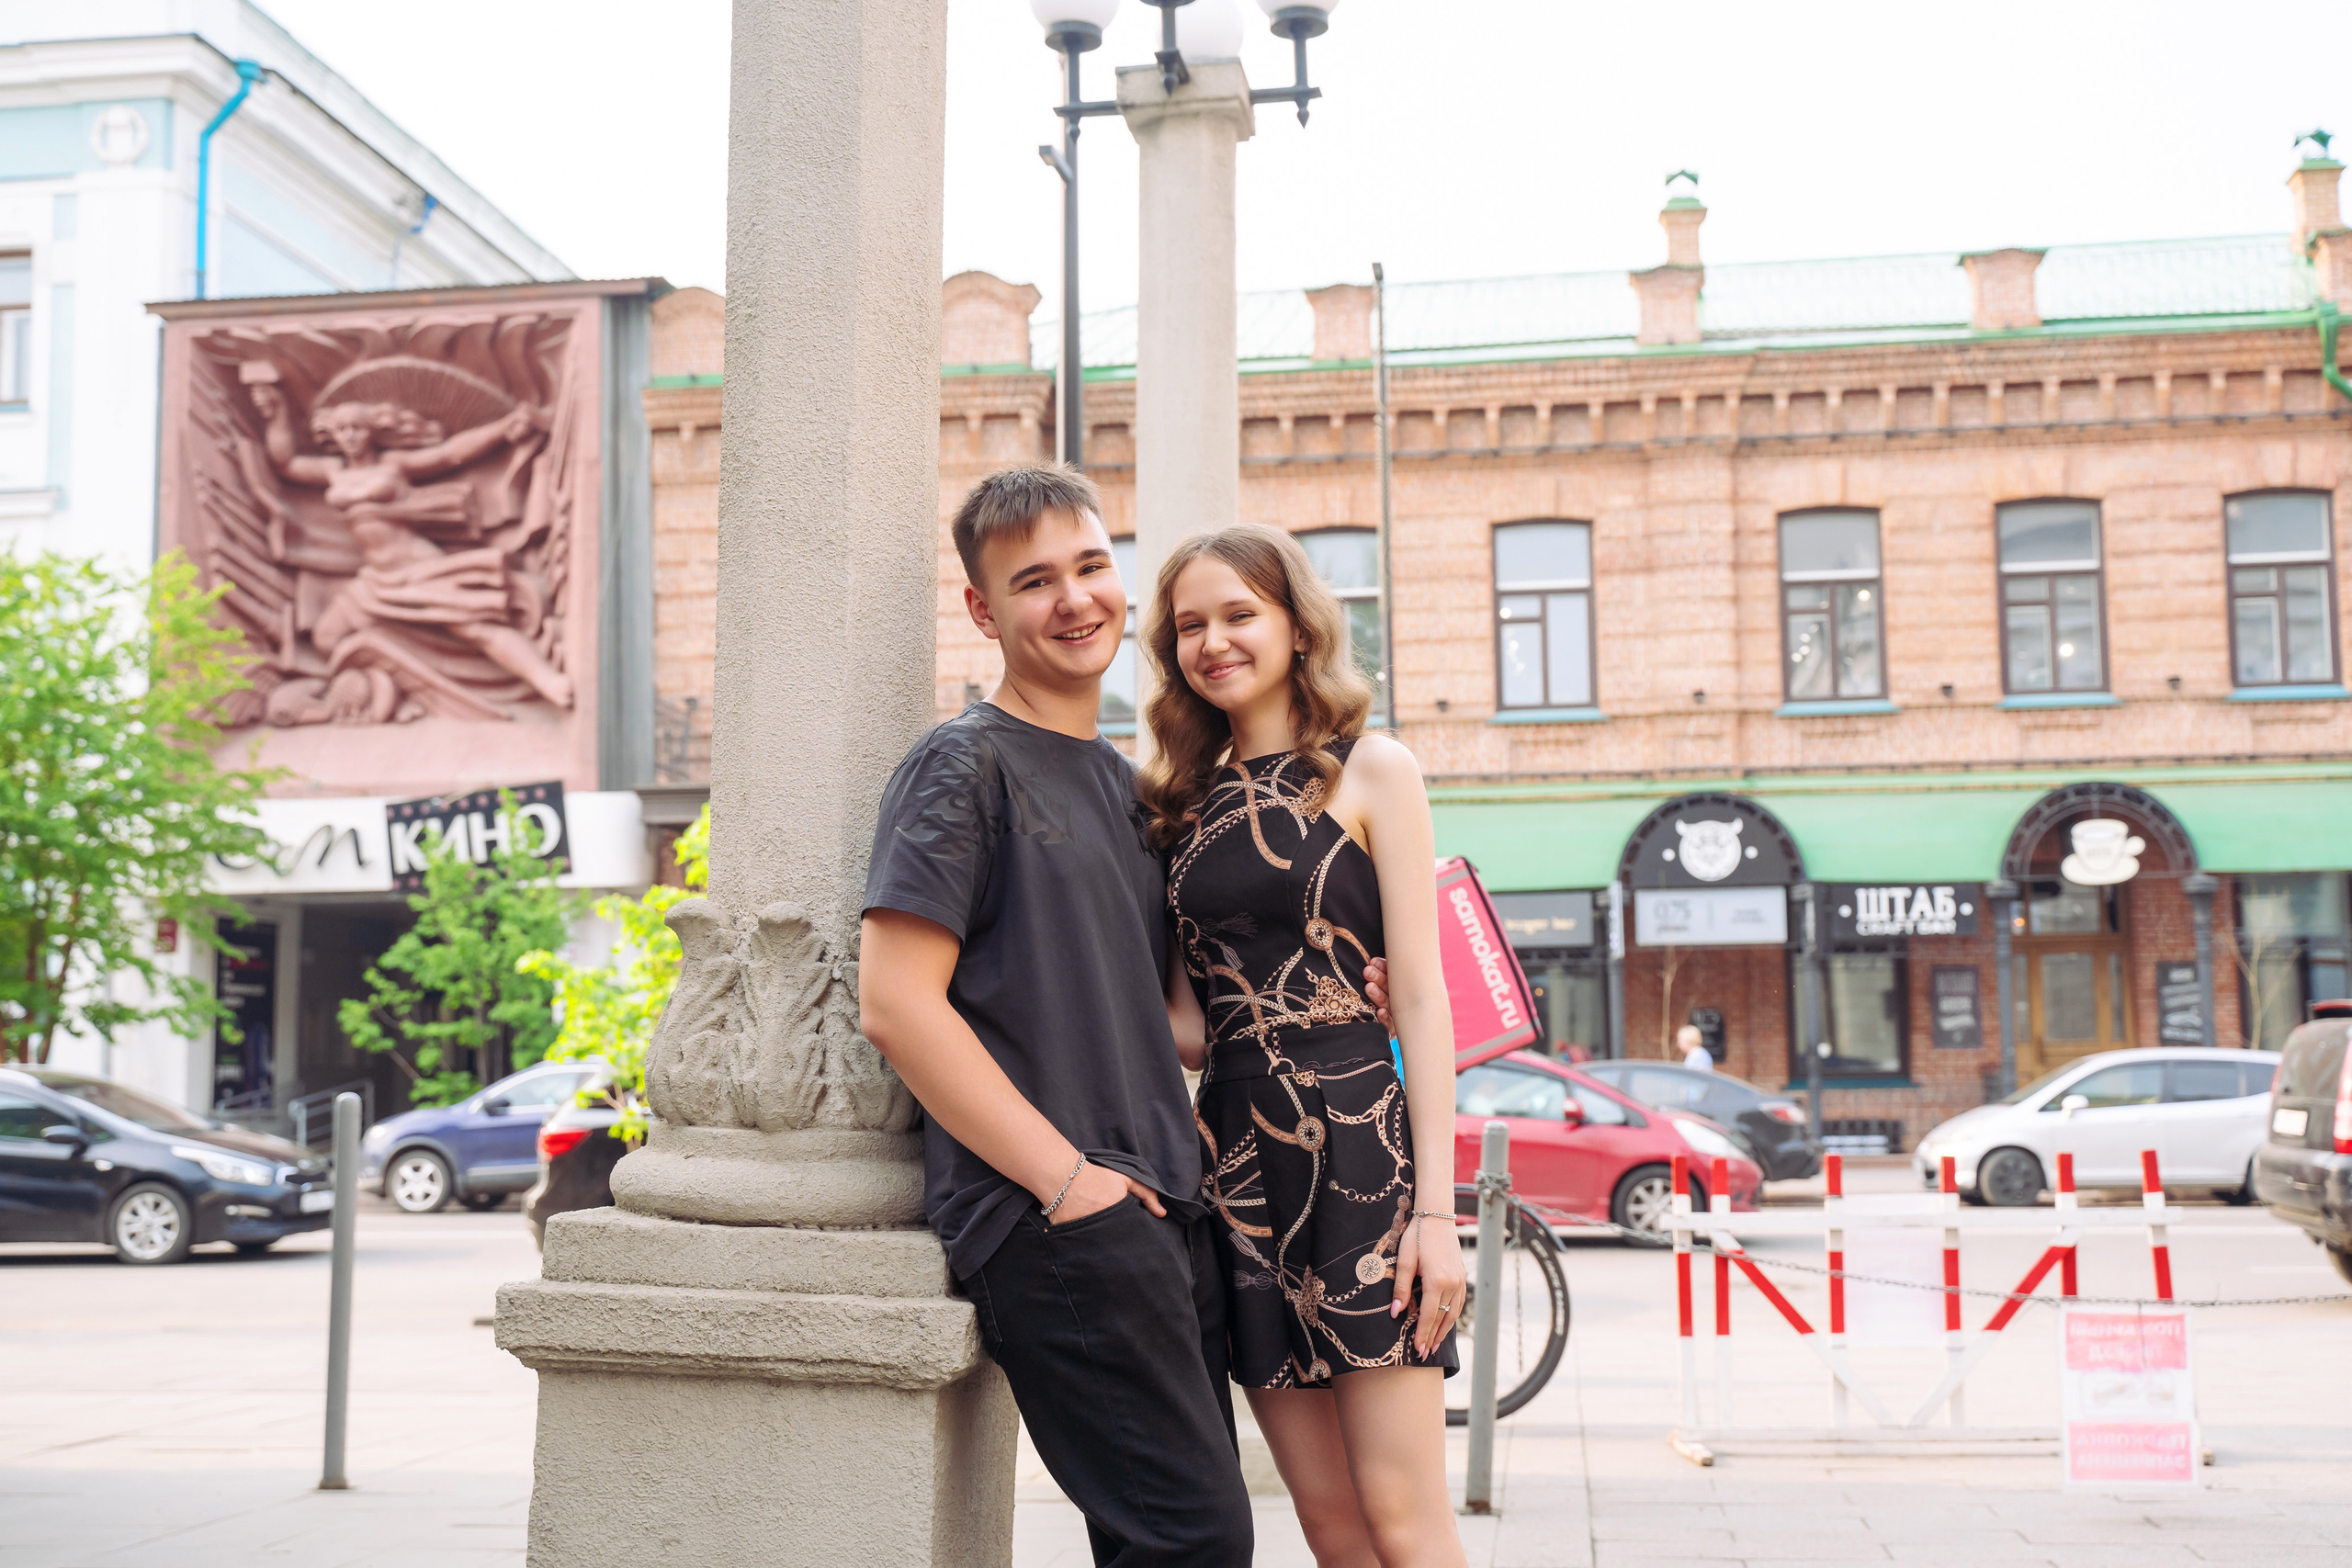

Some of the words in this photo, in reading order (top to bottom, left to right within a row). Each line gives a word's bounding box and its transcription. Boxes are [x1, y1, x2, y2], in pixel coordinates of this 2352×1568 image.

[389, 802, 562, 875] КИНО
[1854, 886, 1957, 921] ШТАБ
[1449, 886, 1521, 1030] samokat.ru
